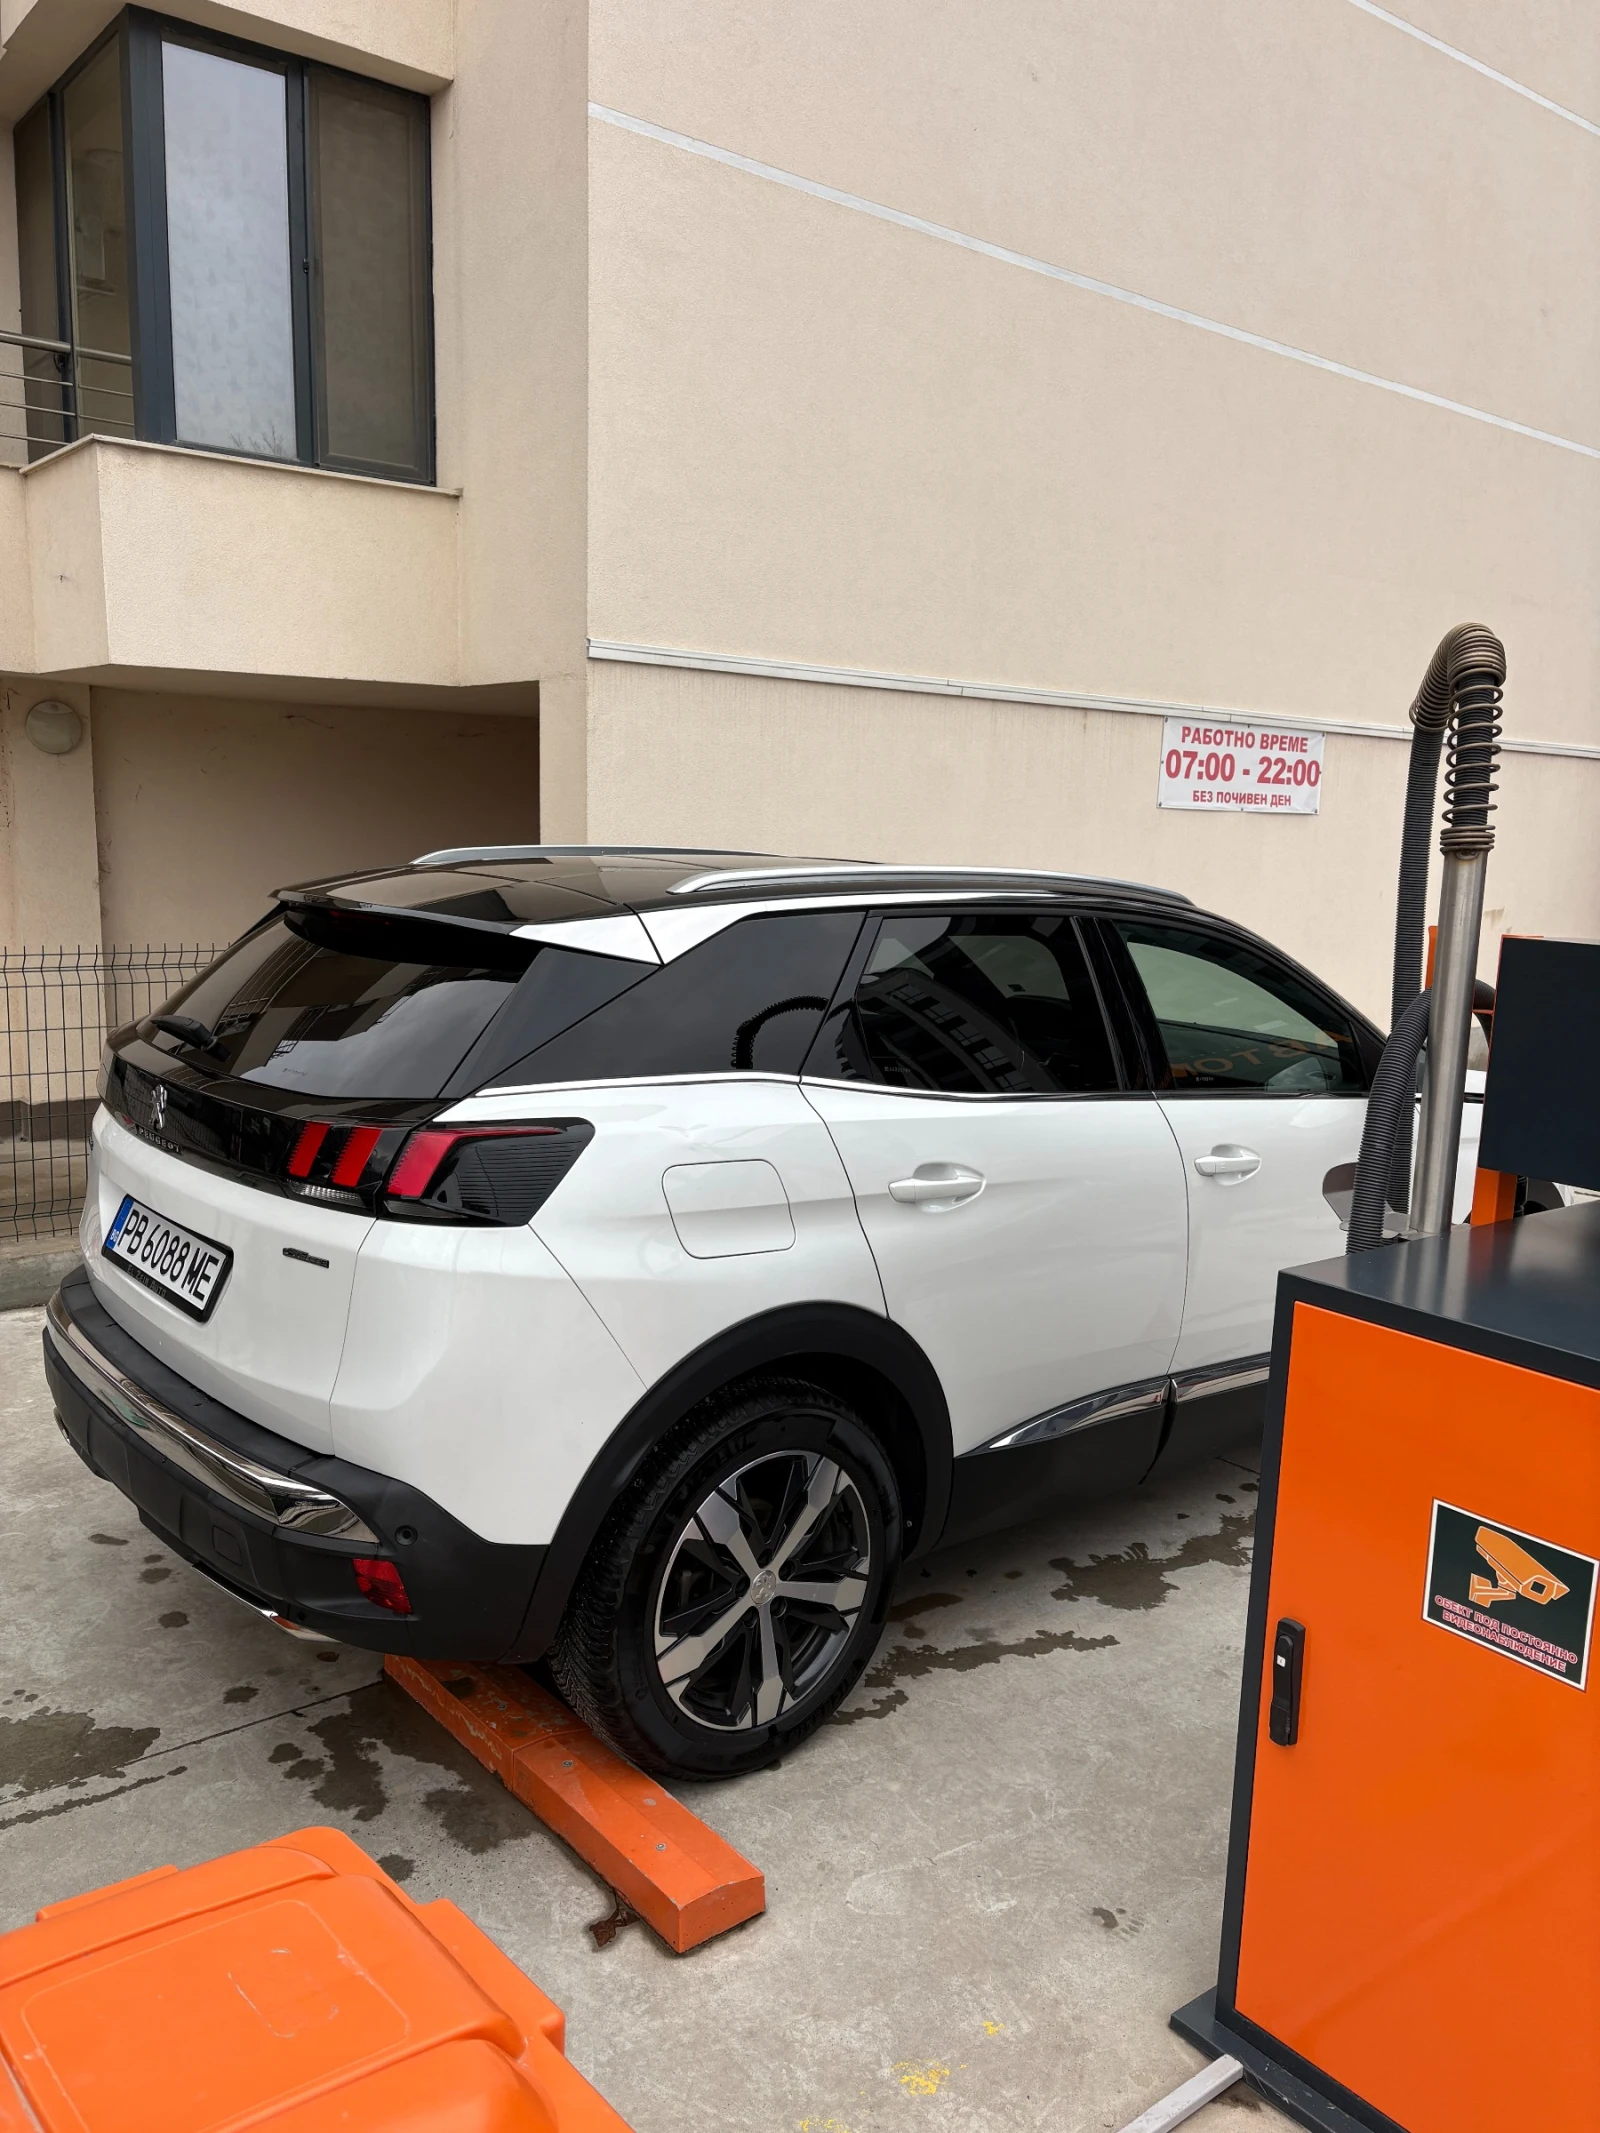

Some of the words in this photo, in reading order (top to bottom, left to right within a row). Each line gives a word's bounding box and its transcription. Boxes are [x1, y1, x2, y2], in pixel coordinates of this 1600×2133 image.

[1181, 726, 1256, 749] РАБОТНО
[1259, 733, 1309, 753] ВРЕМЕ
[1165, 749, 1235, 782] 07:00
[1257, 756, 1320, 787] 22:00
[1192, 790, 1213, 803] БЕЗ
[1216, 791, 1267, 805] ПОЧИВЕН
[1270, 794, 1291, 808] ДЕН
[138, 1125, 180, 1153] PEUGEOT
[1434, 1595, 1473, 1617] ОБЕКТ
[1474, 1609, 1500, 1631] ПОД
[1501, 1618, 1578, 1664] ПОСТОЯННО
[1442, 1609, 1566, 1673] ВИДЕОНАБЛЮДЕНИЕ
